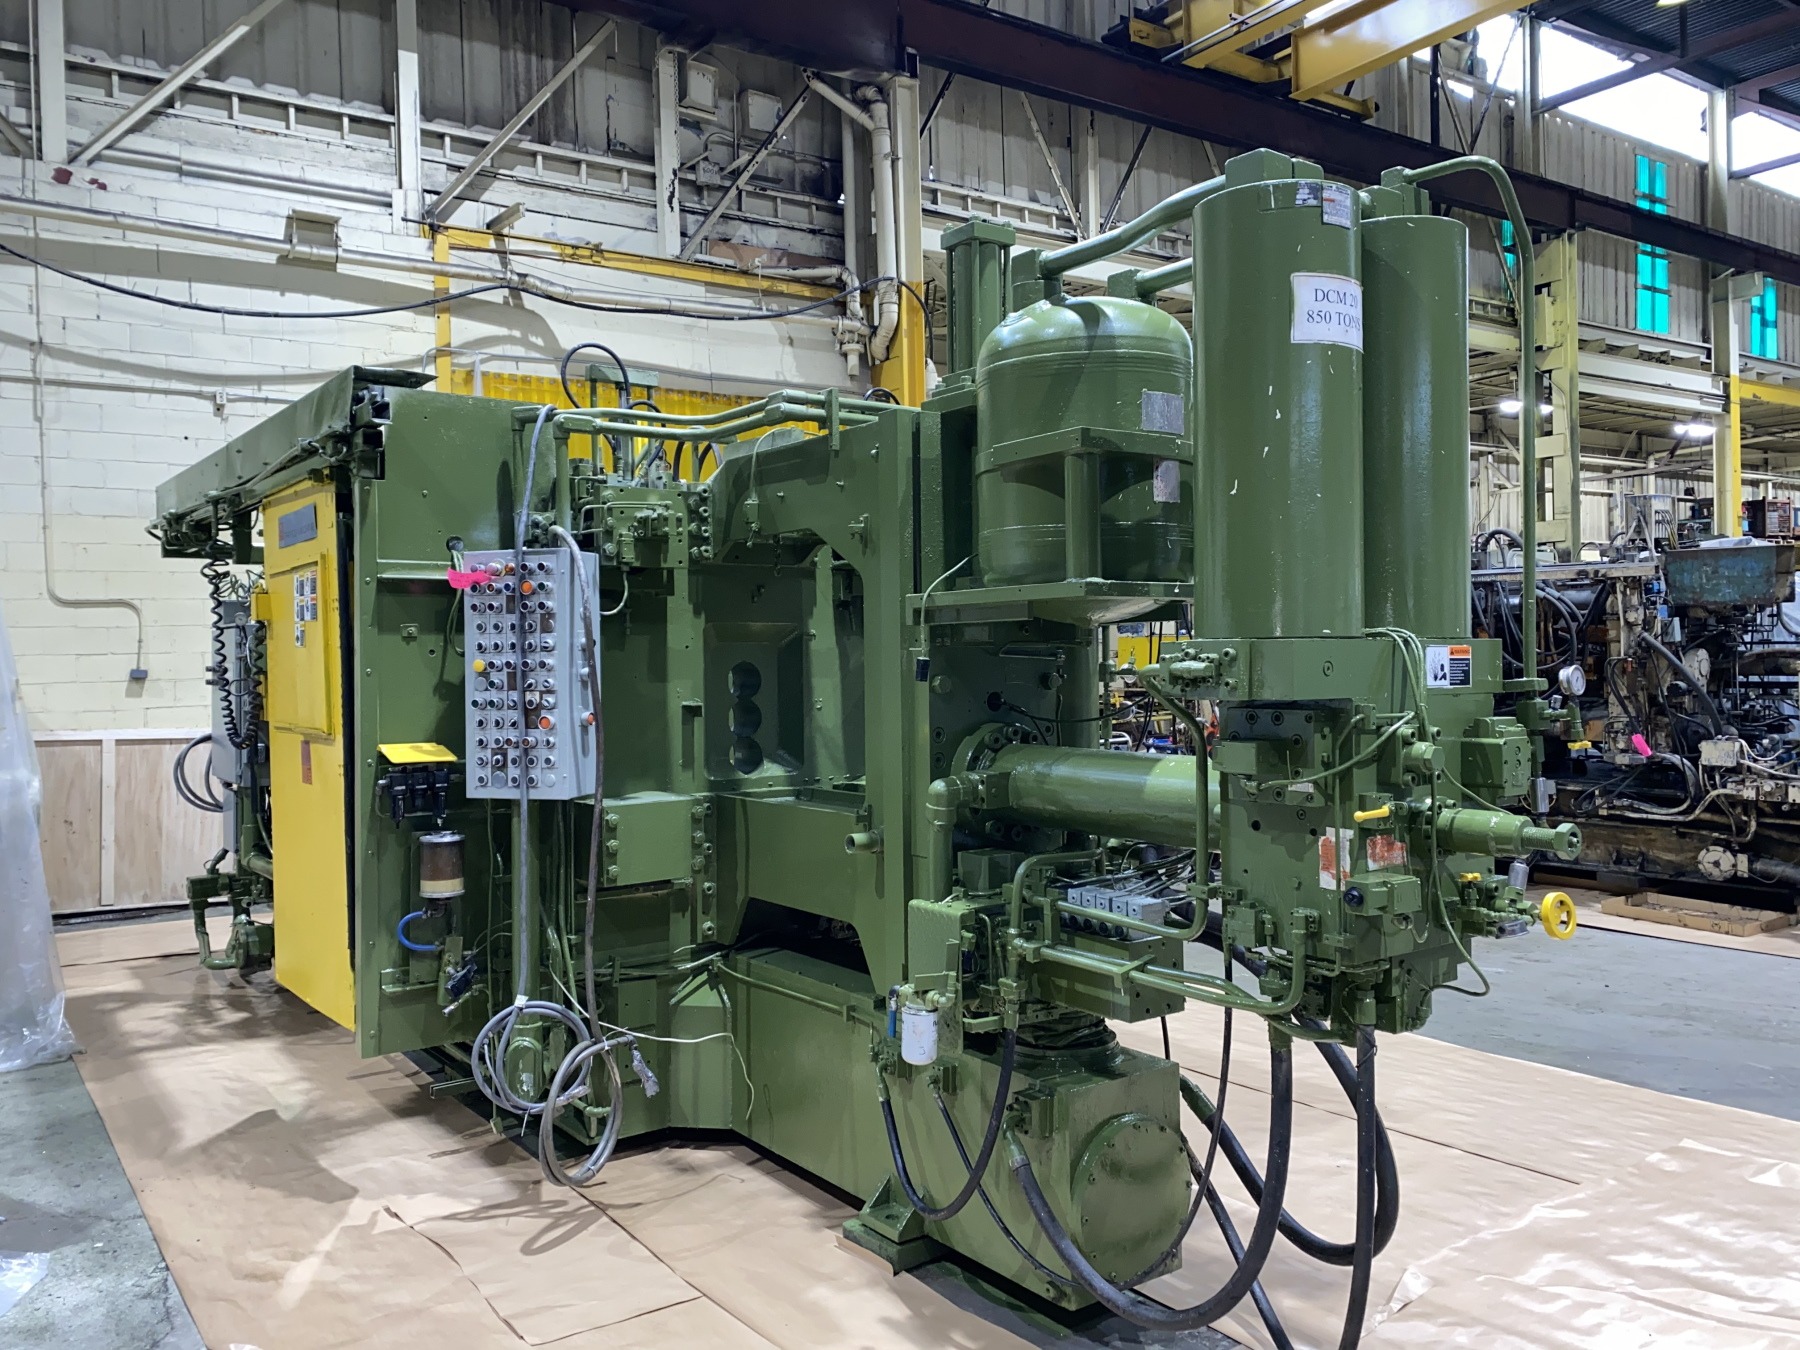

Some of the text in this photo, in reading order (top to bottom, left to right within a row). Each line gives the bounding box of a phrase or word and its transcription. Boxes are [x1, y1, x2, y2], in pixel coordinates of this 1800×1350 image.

[1314, 288, 1347, 306] DCM
[1306, 309, 1361, 332] 850 TONS
